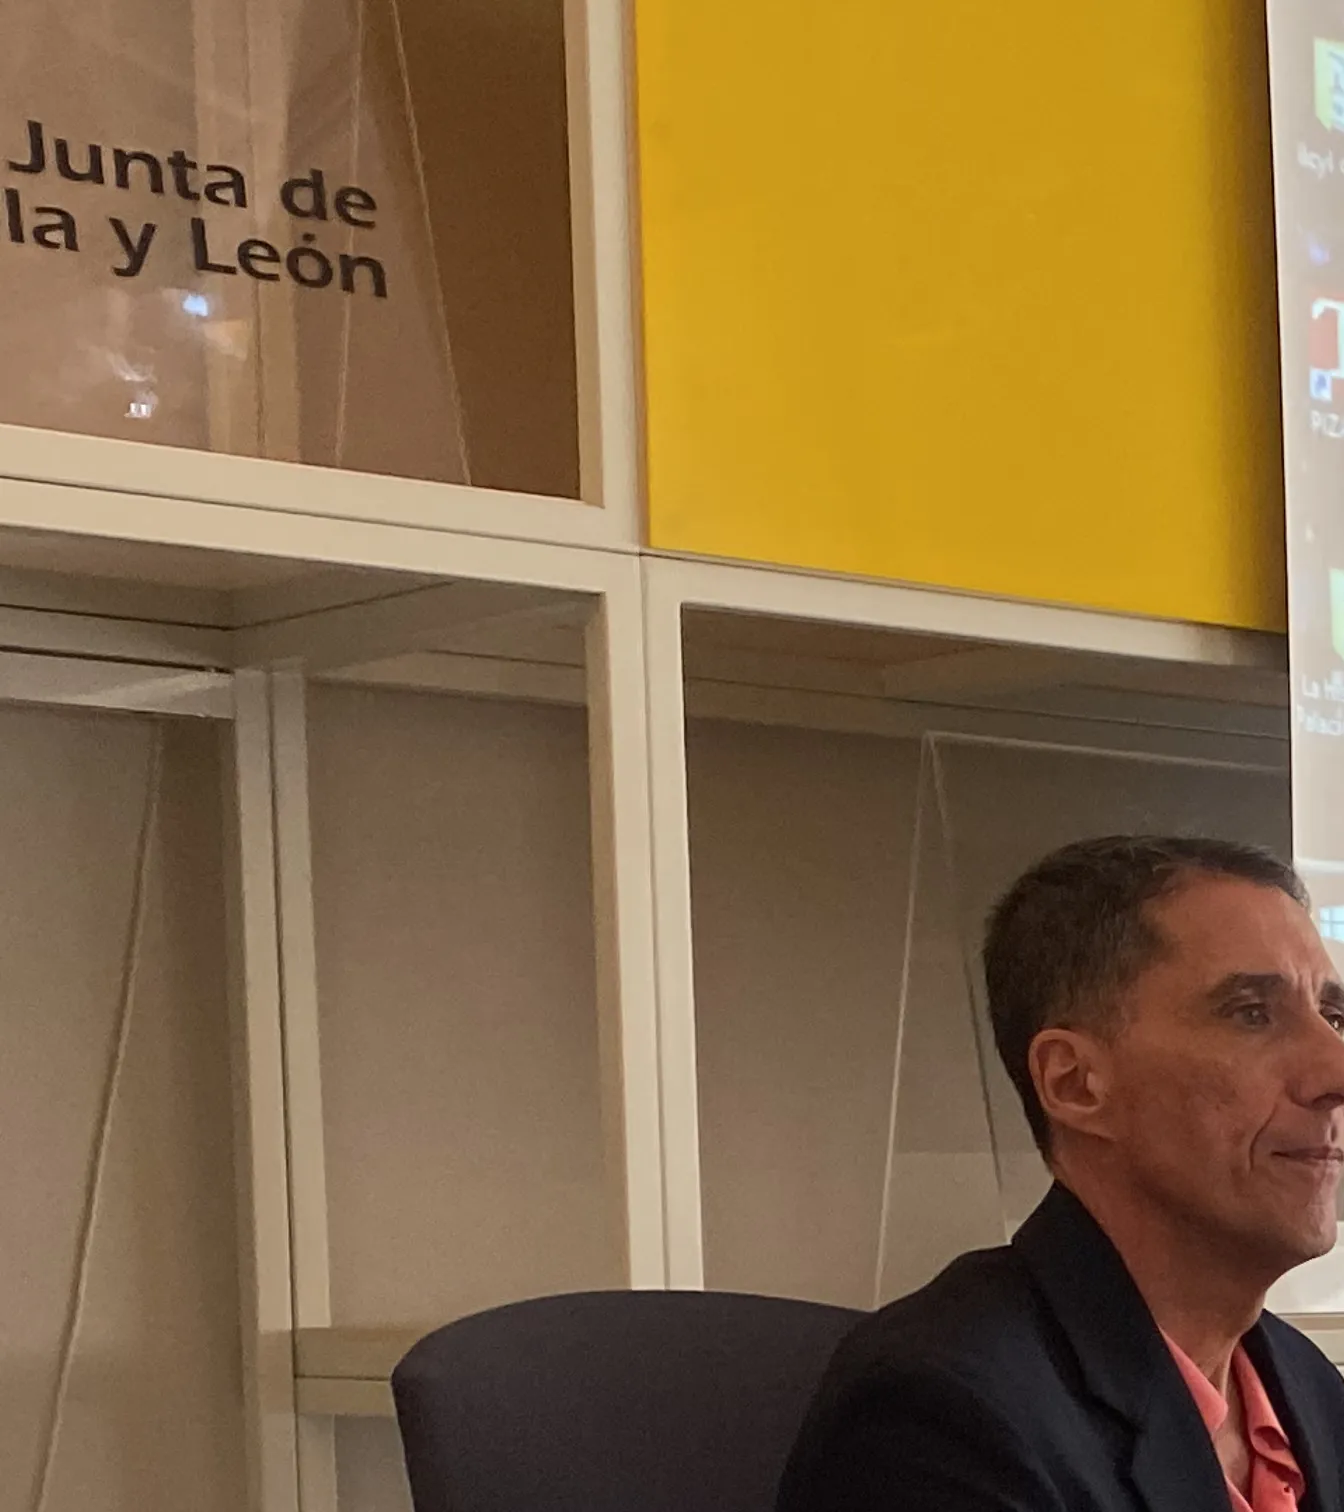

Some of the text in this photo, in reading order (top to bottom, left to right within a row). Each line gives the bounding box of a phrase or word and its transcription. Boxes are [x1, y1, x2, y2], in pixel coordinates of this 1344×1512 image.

[8, 120, 378, 229] Junta de
[2, 187, 389, 298] la y León
[1301, 675, 1320, 699] La
